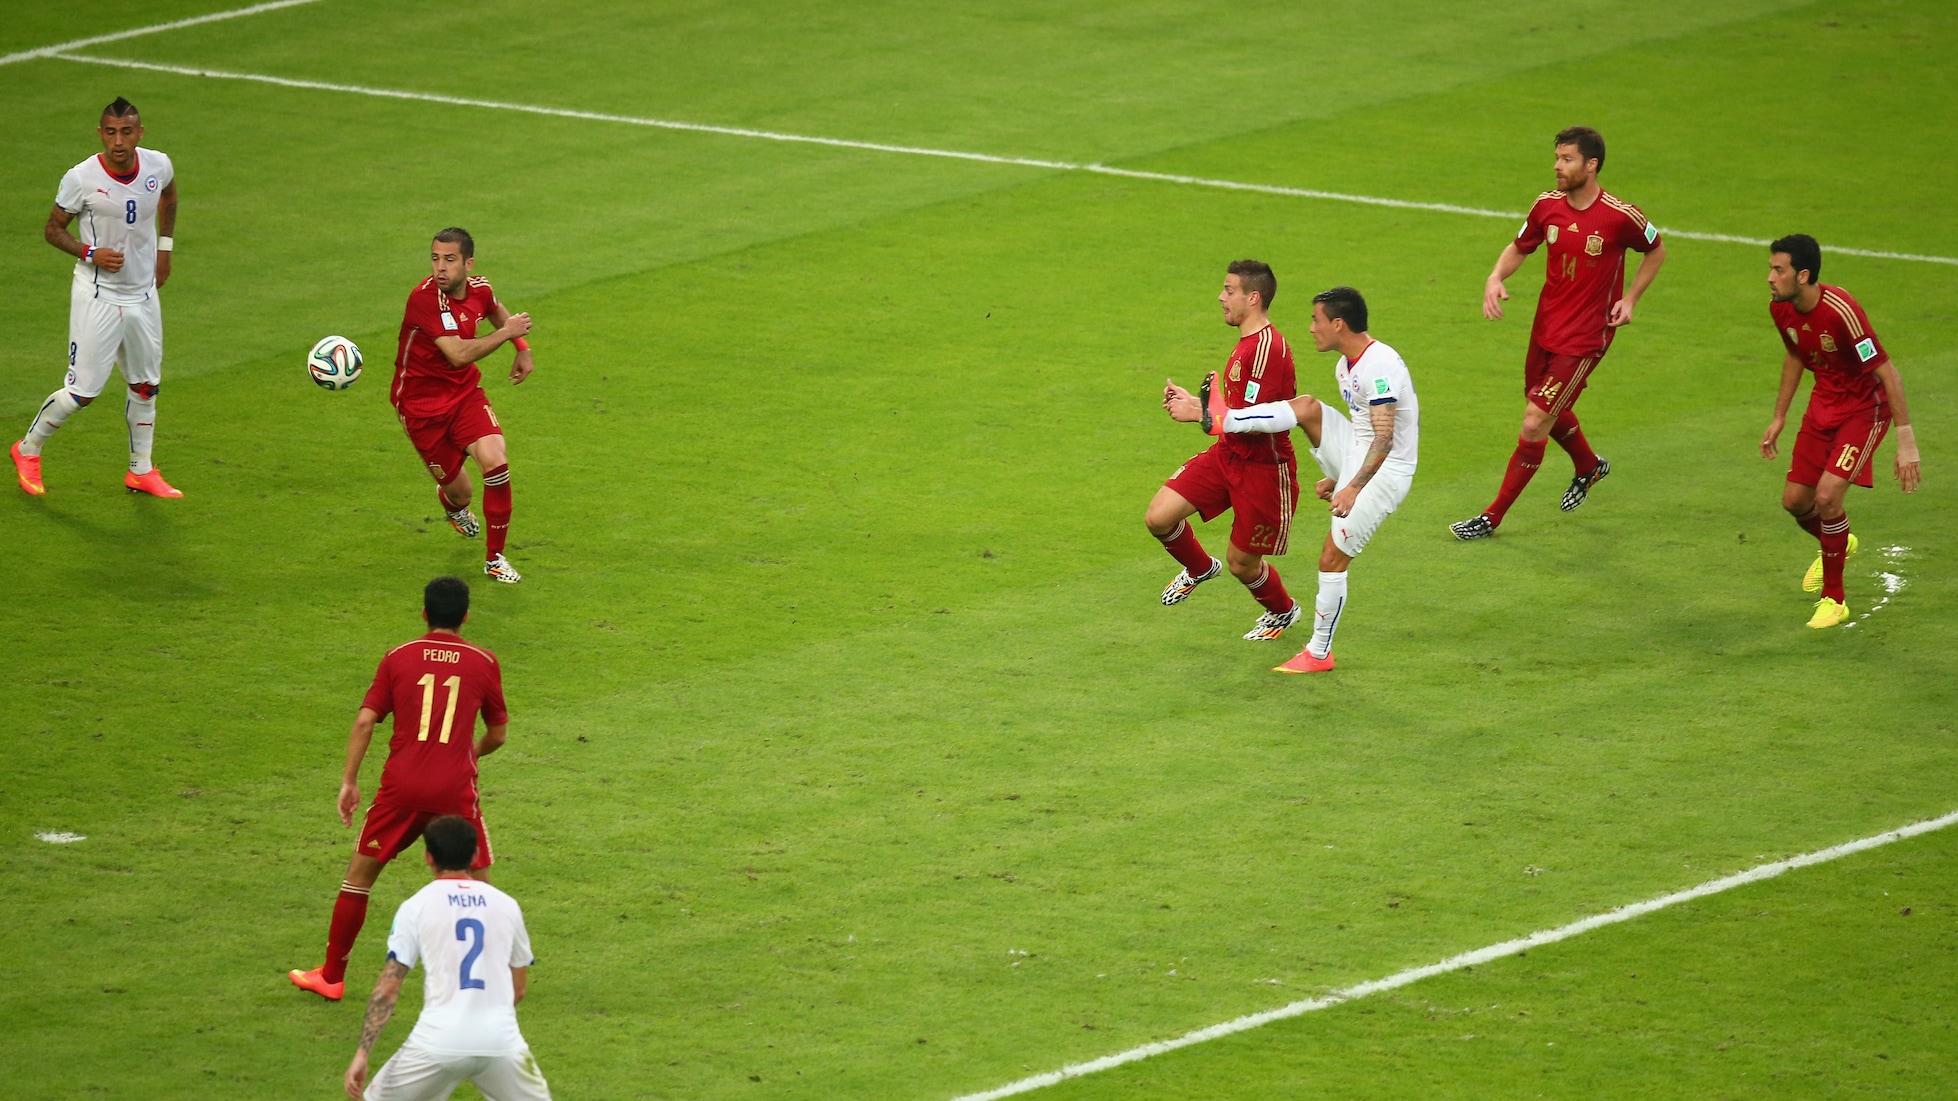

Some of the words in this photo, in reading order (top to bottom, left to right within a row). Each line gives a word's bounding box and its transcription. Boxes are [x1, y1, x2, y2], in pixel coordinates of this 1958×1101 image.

[126, 199, 137, 225] 8
[1561, 253, 1577, 282] 14
[1835, 443, 1860, 472] 16
[1250, 524, 1276, 549] 22
[423, 648, 461, 664] PEDRO
[416, 673, 461, 744] 11
[447, 893, 487, 908] MENA
[455, 917, 486, 990] 2
